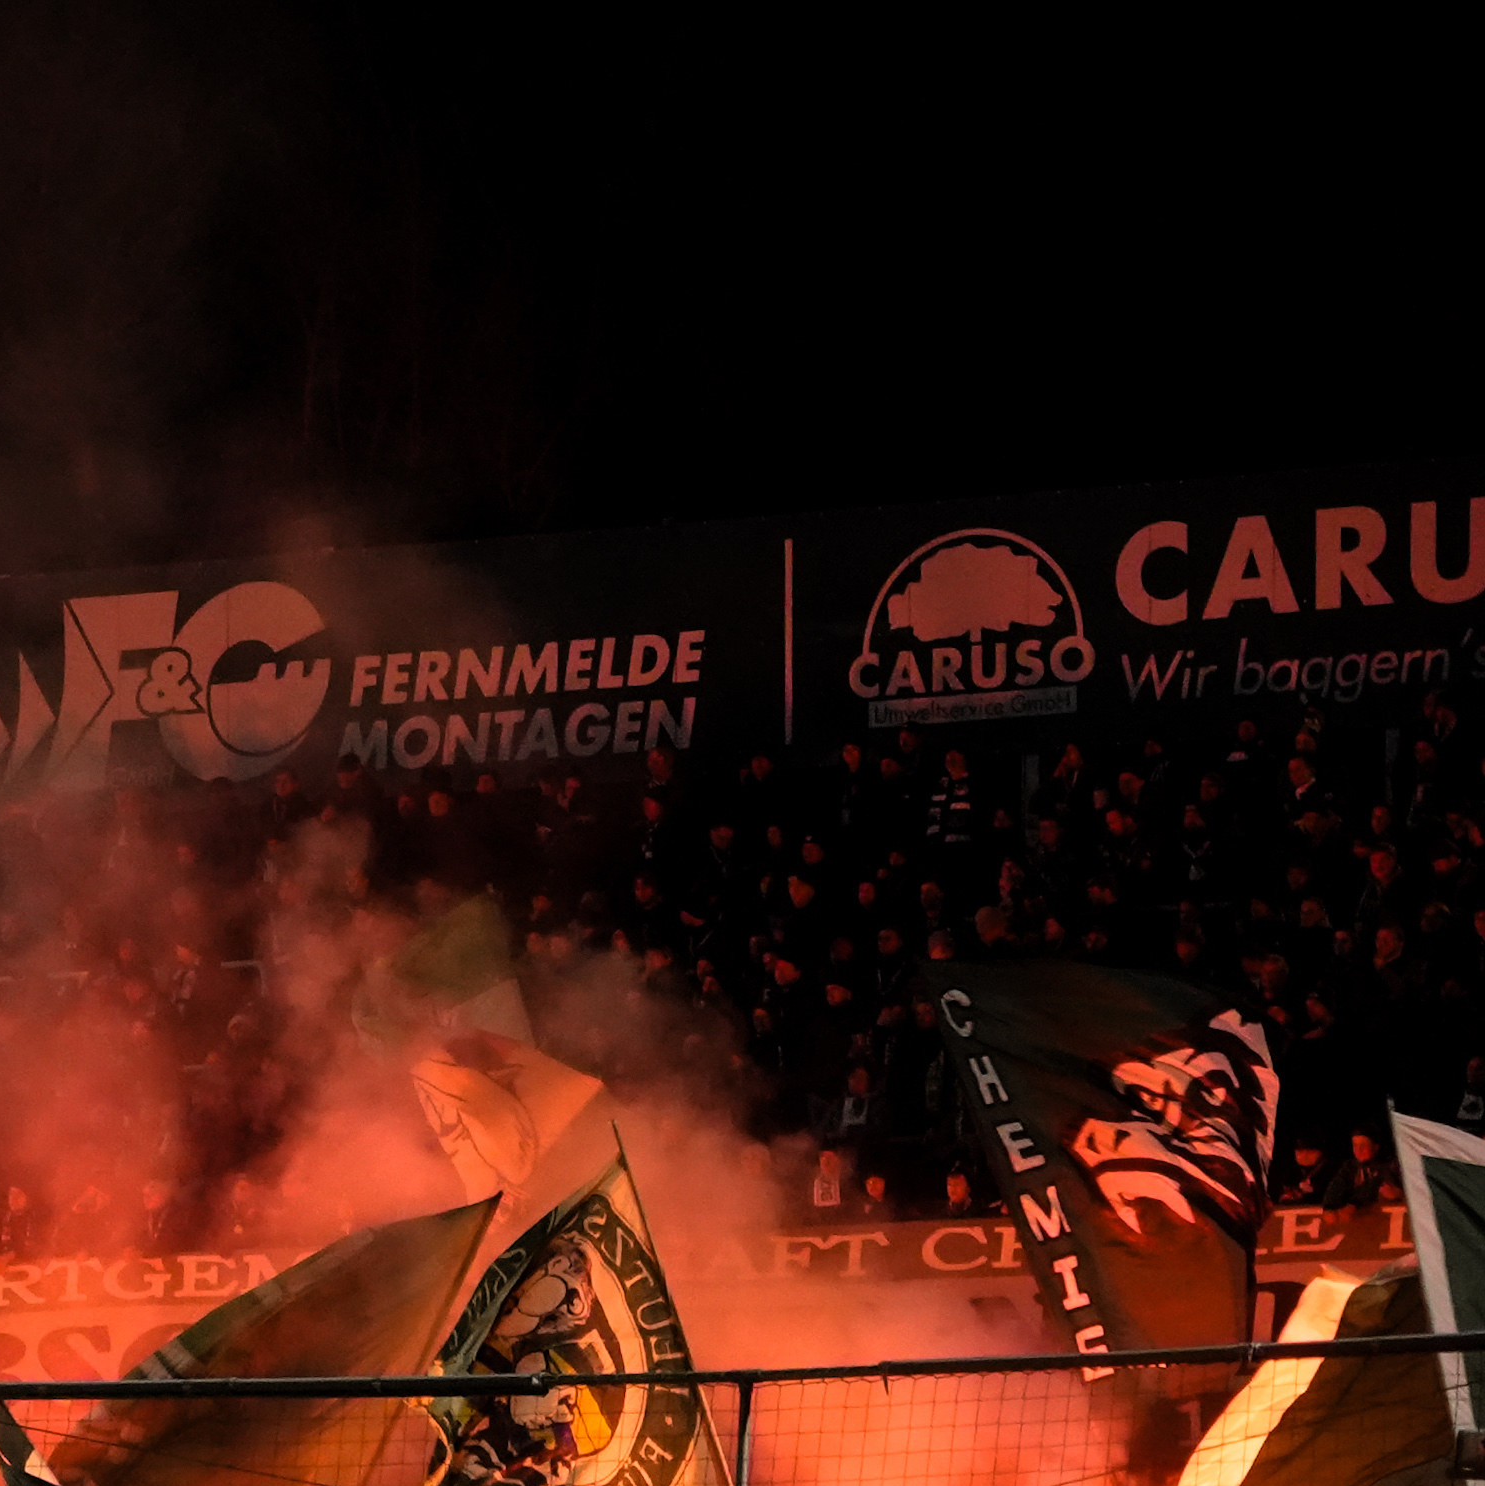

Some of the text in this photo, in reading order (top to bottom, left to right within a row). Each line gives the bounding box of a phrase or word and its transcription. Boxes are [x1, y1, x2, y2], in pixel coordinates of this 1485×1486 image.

[349, 629, 707, 707] FERNMELDE
[849, 634, 1097, 699] CARUSO
[1120, 648, 1218, 704] Wir
[337, 697, 697, 772] MONTAGEN
[874, 691, 1071, 725] Umweltservice GmbH
